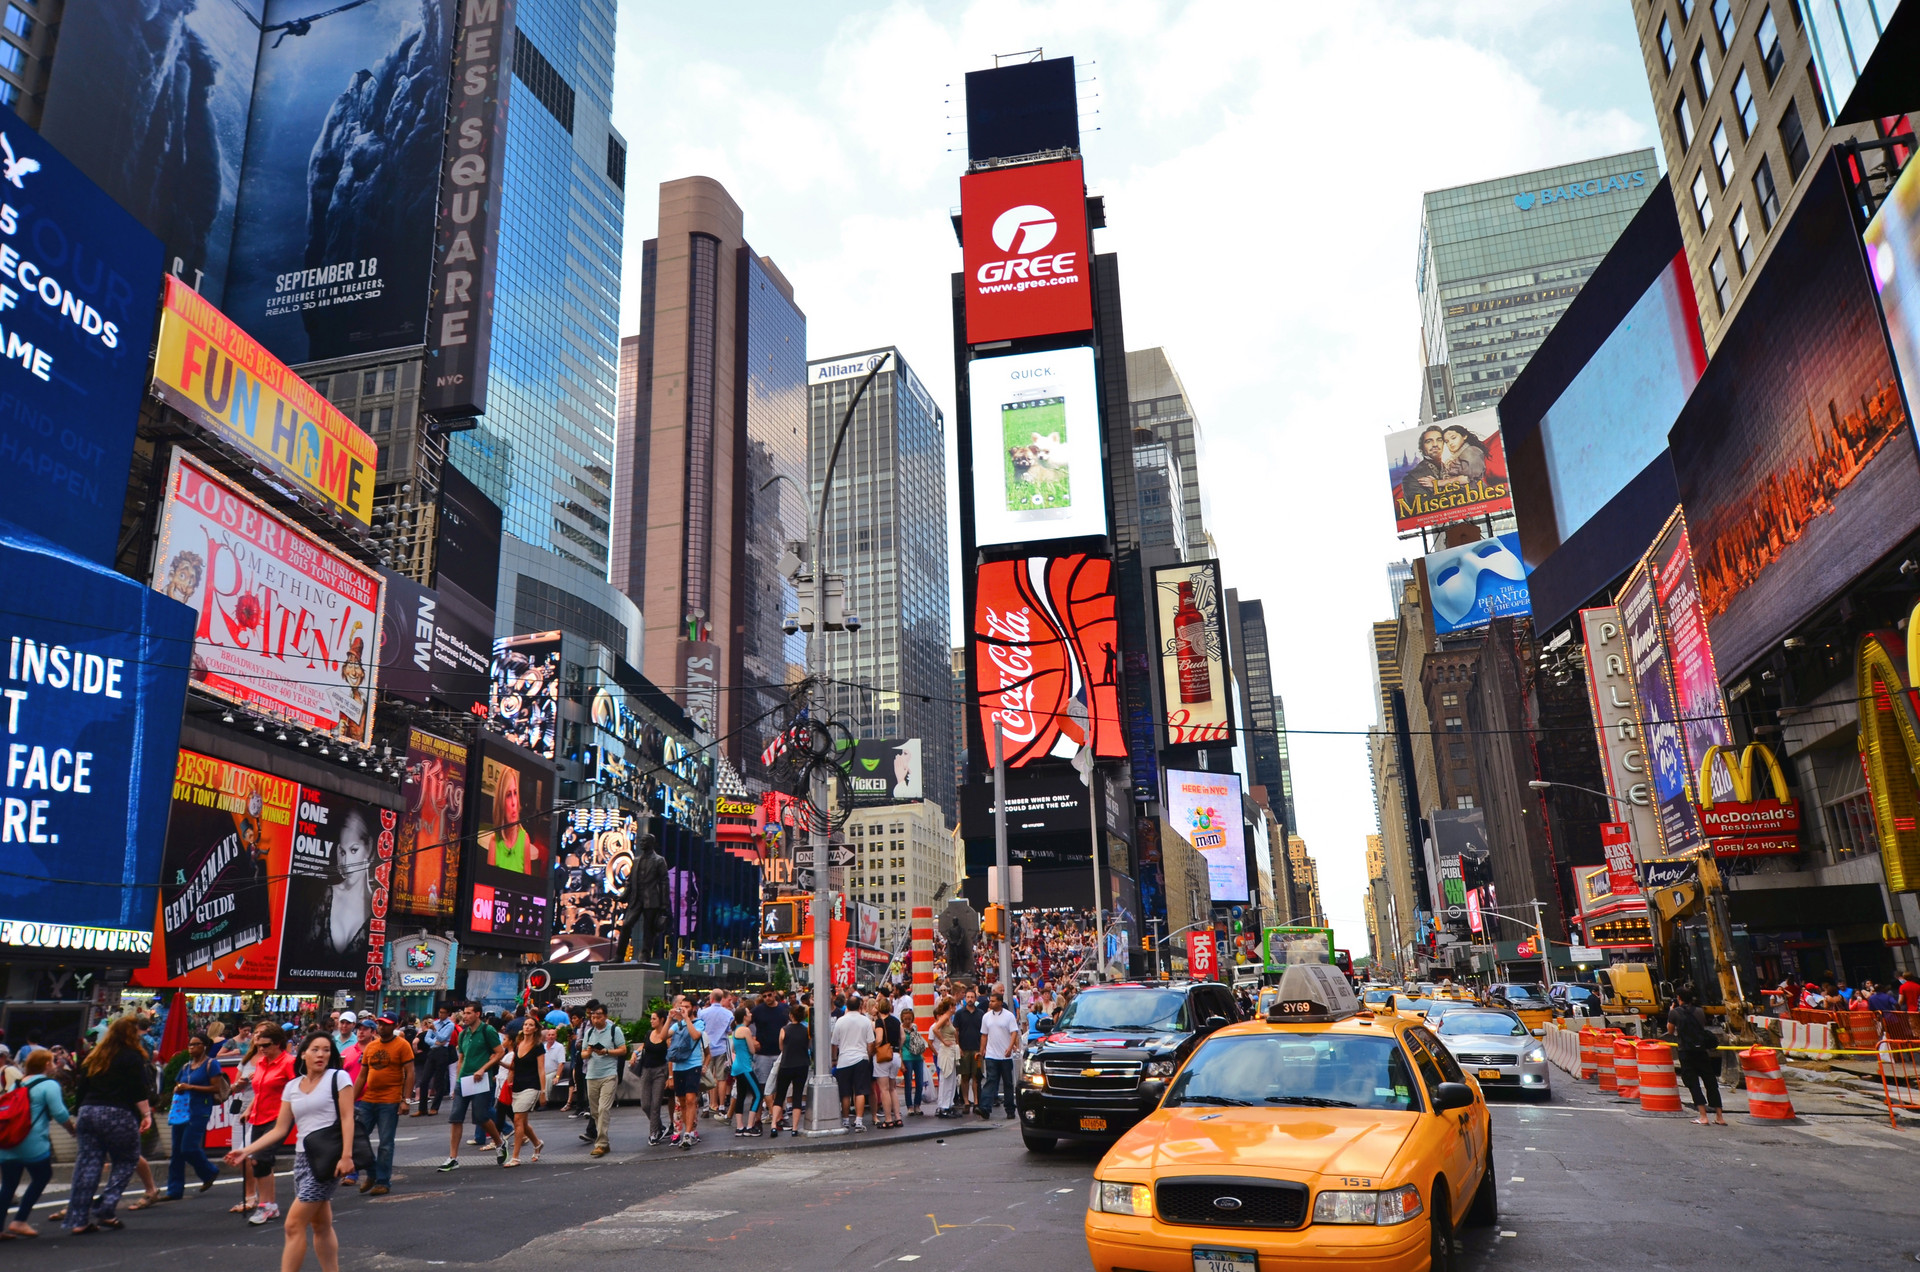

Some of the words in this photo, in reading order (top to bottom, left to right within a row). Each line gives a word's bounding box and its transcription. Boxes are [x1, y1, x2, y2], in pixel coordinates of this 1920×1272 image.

[1540, 171, 1645, 204] BARCLAYS
[434, 117, 487, 347] SQUARE
[275, 261, 355, 293] SEPTEMBER
[358, 257, 379, 280] 18
[975, 251, 1077, 283] GREE
[266, 291, 315, 308] EXPERIENCE
[317, 289, 327, 299] IT
[329, 287, 339, 297] IN
[341, 278, 385, 294] THEATERS.
[978, 273, 1079, 295] www.gree.com
[318, 298, 331, 308] AND
[364, 289, 381, 300] 3D
[173, 283, 228, 346] WINNER!
[229, 328, 255, 369] 2015
[256, 350, 282, 391] BEST
[282, 370, 323, 427] MUSICAL
[324, 404, 348, 442] TONY
[347, 422, 378, 465] AWARD
[436, 373, 464, 387] NYC
[818, 362, 864, 379] Allianz
[1010, 367, 1056, 380] QUICK.
[179, 328, 261, 438] FUN
[1431, 478, 1461, 496] Les
[1396, 480, 1507, 520] Misérables
[178, 465, 286, 557] LOSER!
[221, 529, 338, 609] SOMETHING
[289, 536, 318, 562] BEST
[322, 556, 372, 595] MUSICAL!
[288, 550, 309, 572] 2015
[311, 564, 337, 588] TONY
[337, 580, 371, 607] AWARD
[1499, 584, 1515, 594] THE
[1478, 588, 1529, 609] PHANTO
[1496, 603, 1511, 612] THE
[1511, 598, 1531, 608] OPER
[413, 595, 436, 672] NEW
[434, 626, 451, 642] Clear
[450, 635, 464, 651] Black
[463, 643, 490, 668] Processing
[434, 637, 459, 659] Improves
[459, 651, 473, 667] Local
[472, 660, 485, 674] Area
[8, 635, 124, 699] INSIDE
[433, 648, 458, 669] Contrast
[986, 606, 1037, 743] Coca-Cola
[257, 678, 279, 696] LEAST
[471, 701, 488, 720] JVC
[1599, 621, 1650, 807] PALACE
[6, 743, 94, 794] FACE
[301, 787, 321, 804] THE
[1030, 796, 1051, 804] WHEN
[1052, 794, 1071, 802] ONLY
[1181, 784, 1202, 794] HERE
[1202, 786, 1209, 794] in
[1209, 786, 1228, 796] NYC!
[192, 787, 218, 809] TONY
[216, 793, 247, 815] AWARD
[261, 805, 291, 826] WINNER
[299, 801, 330, 825] ONE
[1705, 809, 1796, 825] McDonald's
[0, 797, 59, 844] RE.
[298, 820, 318, 837] THE
[1721, 820, 1782, 832] Restaurant
[295, 834, 334, 859] ONLY
[1604, 841, 1632, 860] JERSEY
[1716, 843, 1745, 853] OPEN
[1747, 842, 1760, 850] 24
[798, 853, 814, 862] ONE
[1441, 859, 1460, 868] AUGUS
[1610, 856, 1634, 872] BOYS
[164, 832, 239, 934] GENTLEMAN'S
[176, 868, 187, 885] A
[1442, 867, 1463, 879] PUBL
[1444, 878, 1464, 893] ALW
[195, 893, 236, 925] GUIDE
[364, 807, 398, 993] CHICAGO
[472, 897, 494, 921] CNN
[495, 907, 507, 924] 88
[20, 923, 153, 954] OUTFITTERS
[1193, 934, 1212, 971] tkts
[289, 968, 358, 979] CHICAGOTHEMUSICAL.COM
[192, 995, 242, 1013] GRAND
[264, 995, 299, 1013] SLAM
[1283, 1002, 1310, 1014] 3Y69
[1340, 1177, 1372, 1188] 153
[1219, 1200, 1236, 1209] Ford
